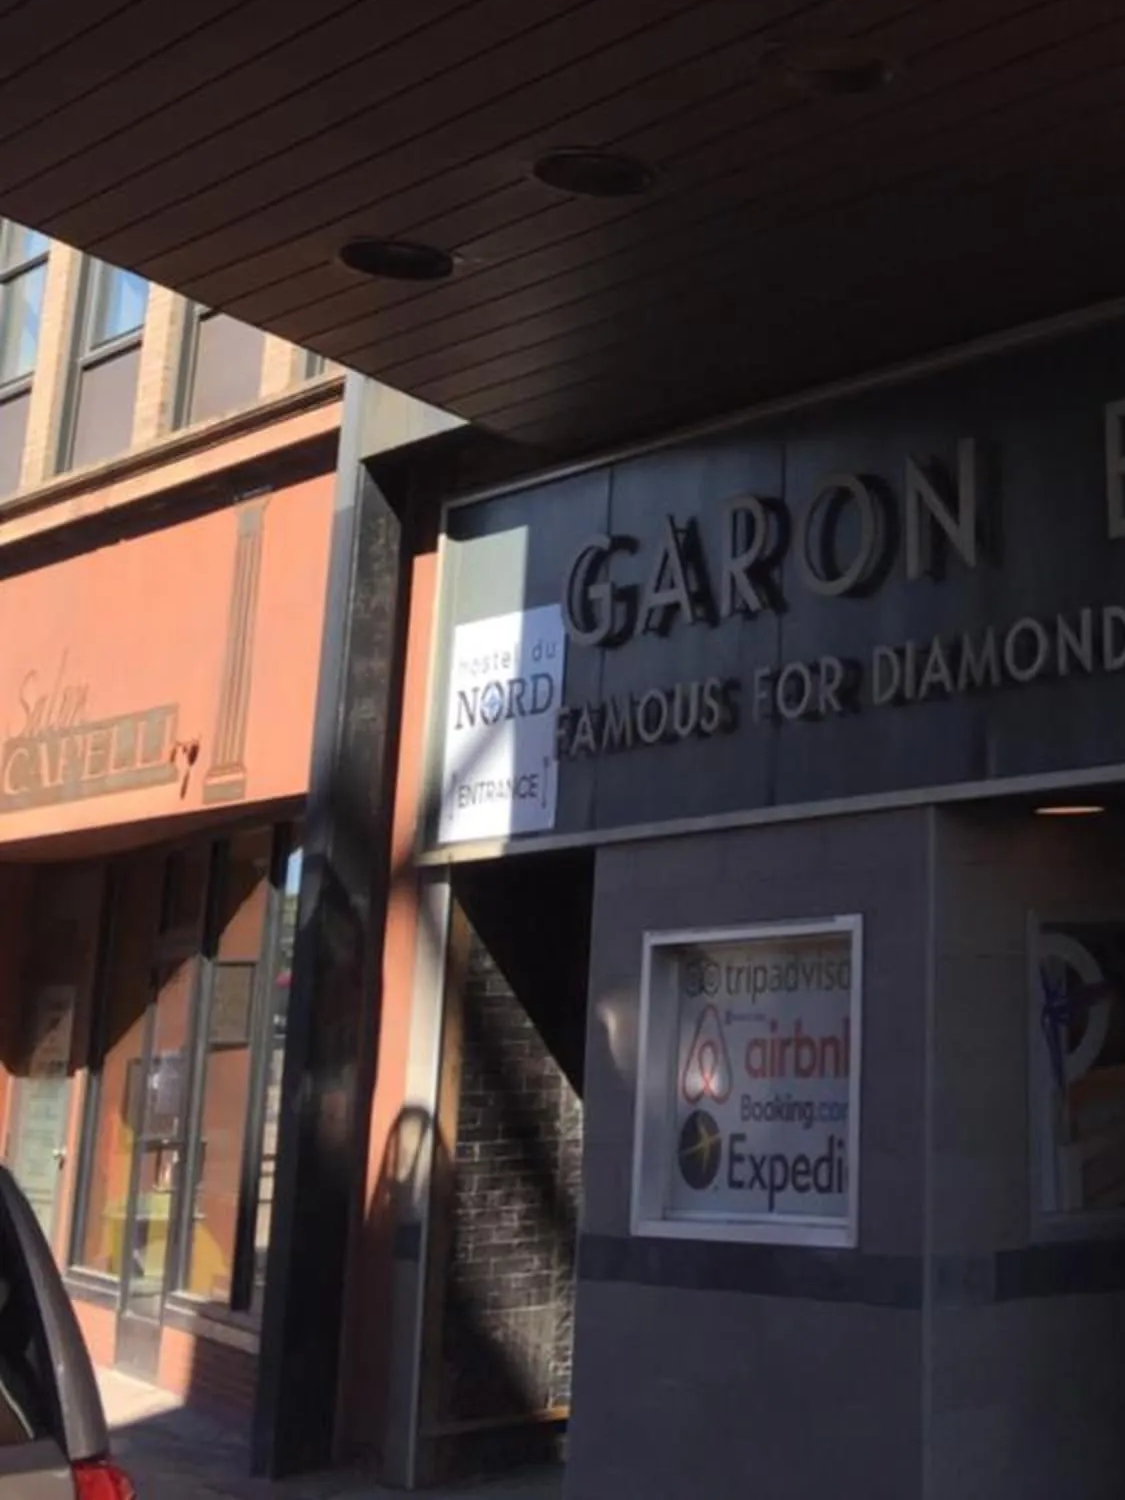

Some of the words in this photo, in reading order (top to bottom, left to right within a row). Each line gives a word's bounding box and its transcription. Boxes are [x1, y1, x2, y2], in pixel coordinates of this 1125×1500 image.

[564, 437, 980, 647] GARON
[457, 644, 521, 675] hostel
[531, 638, 556, 663] du
[454, 672, 554, 730] NORD
[555, 676, 722, 756] FAMOUS
[753, 655, 844, 722] FOR
[3, 713, 176, 795] CAPELLI
[457, 774, 540, 809] ENTRANCE
